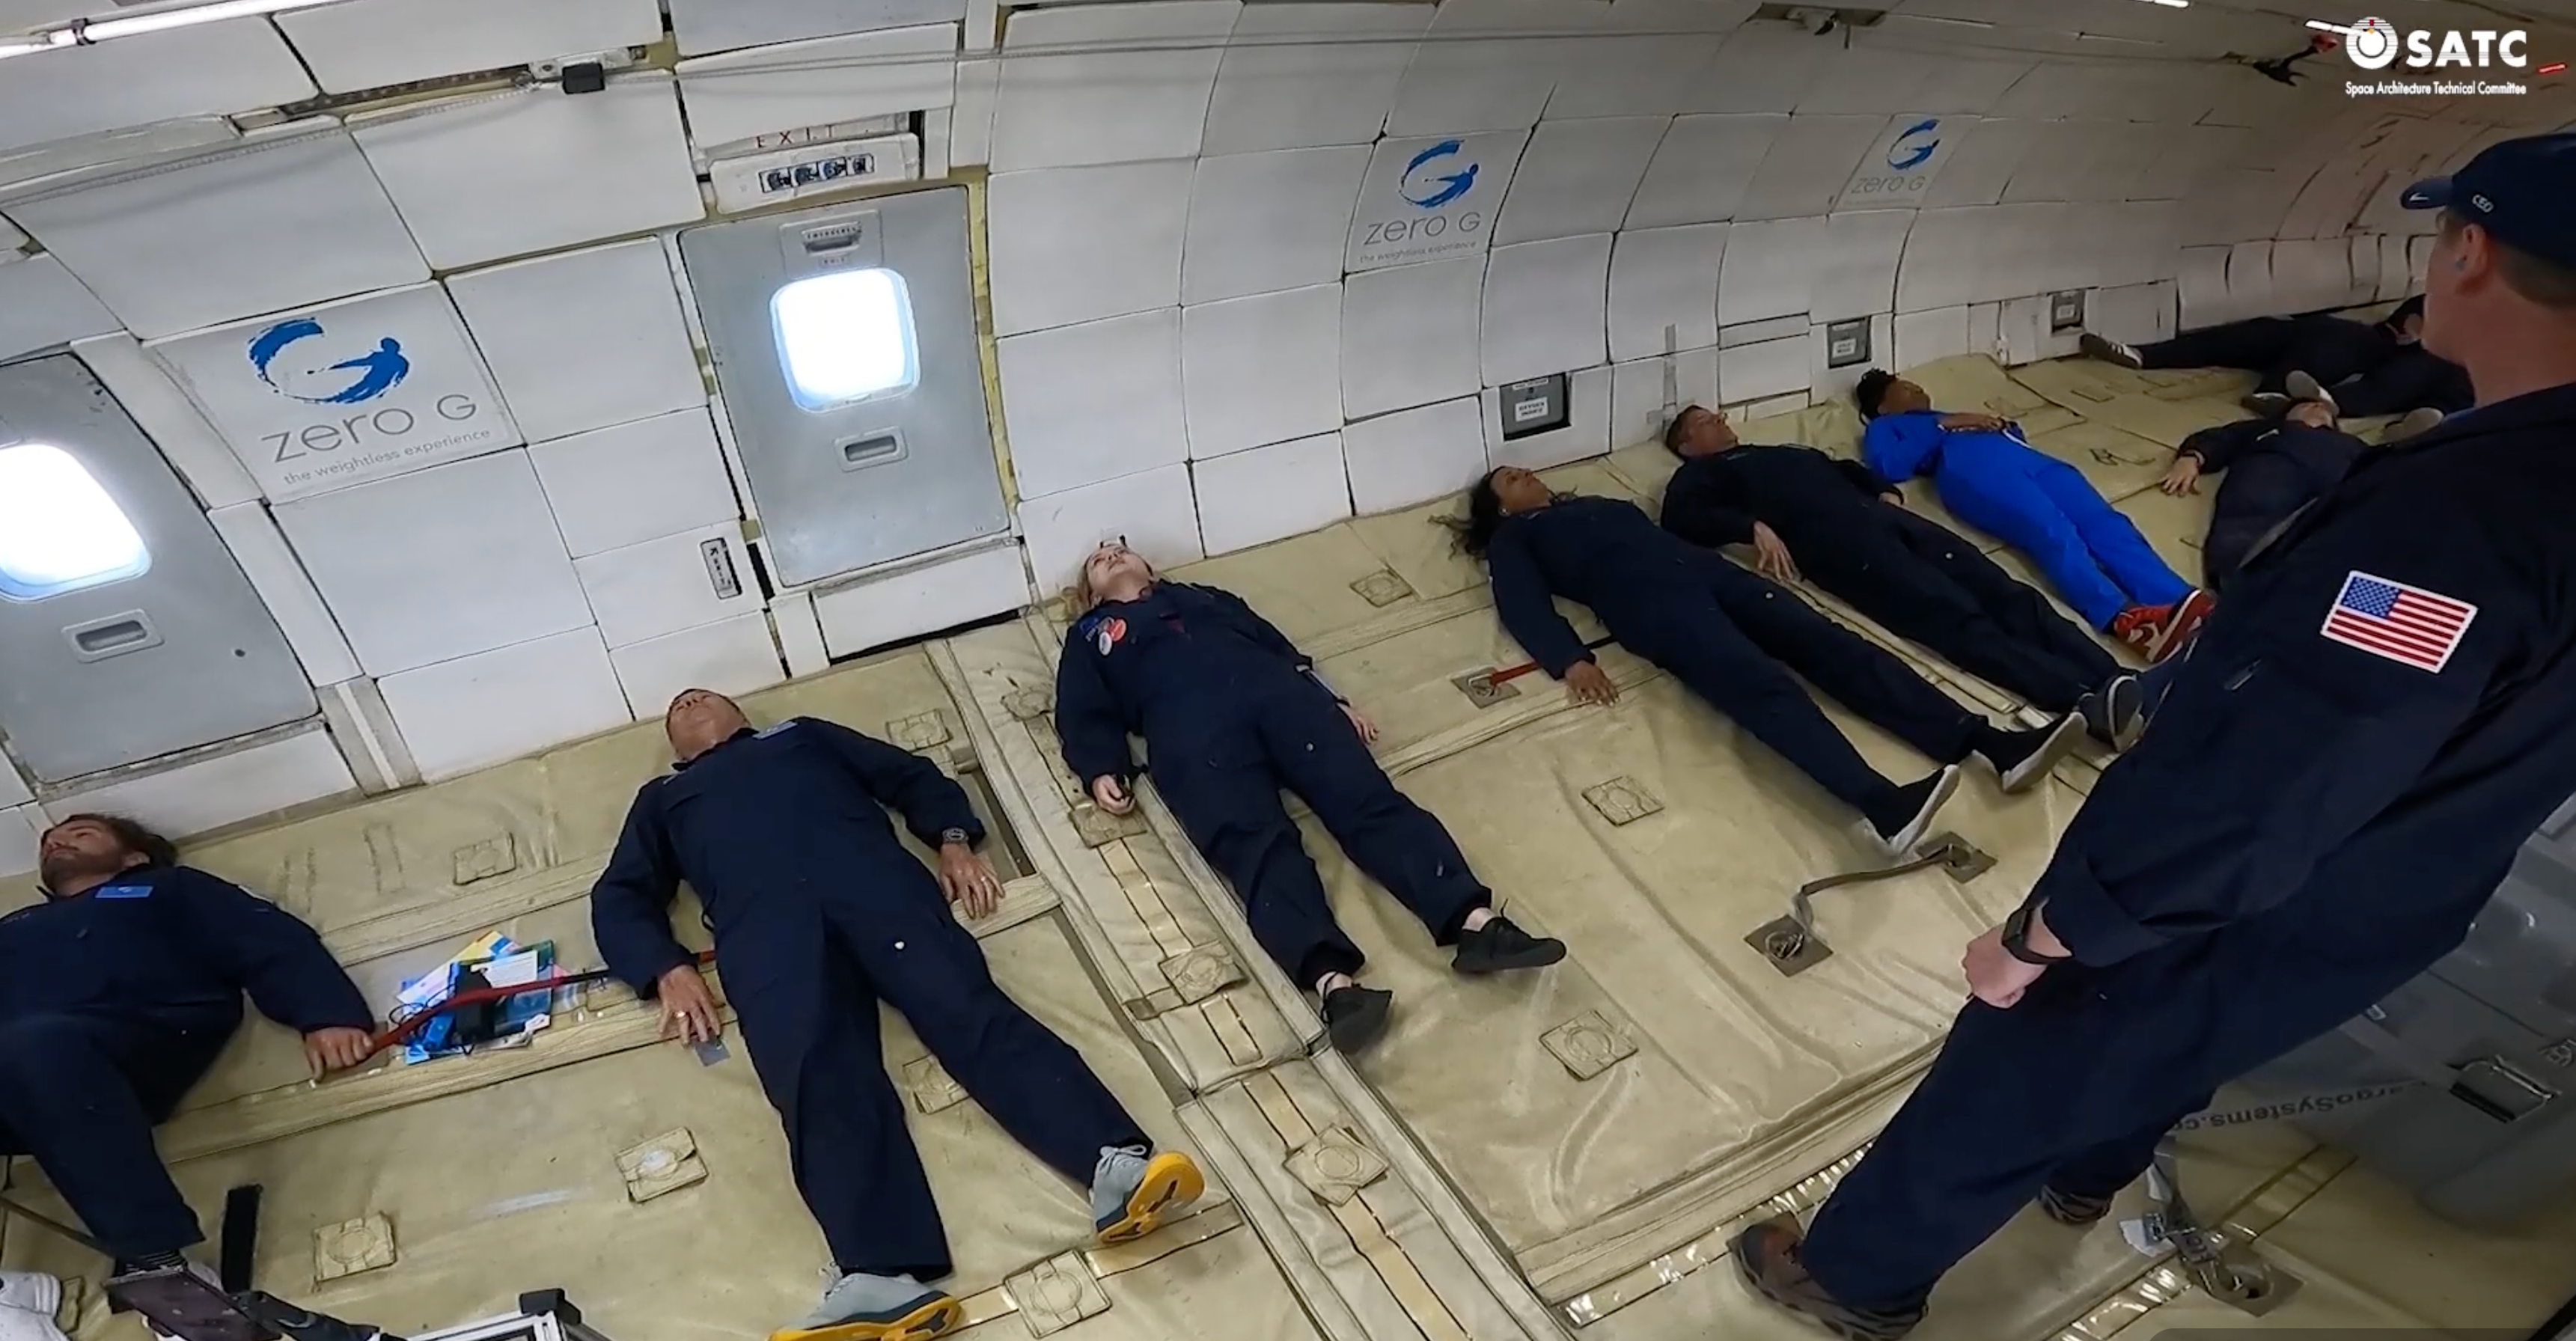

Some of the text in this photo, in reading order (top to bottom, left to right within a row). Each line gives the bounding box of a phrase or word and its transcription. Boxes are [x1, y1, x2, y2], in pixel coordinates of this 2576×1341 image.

[756, 124, 834, 149] EXIT
[1850, 175, 1926, 194] zero G
[2471, 194, 2494, 213] CEO
[1364, 211, 1481, 245] zero G
[261, 394, 477, 463] zero G
[284, 428, 491, 486] the weightless experience
